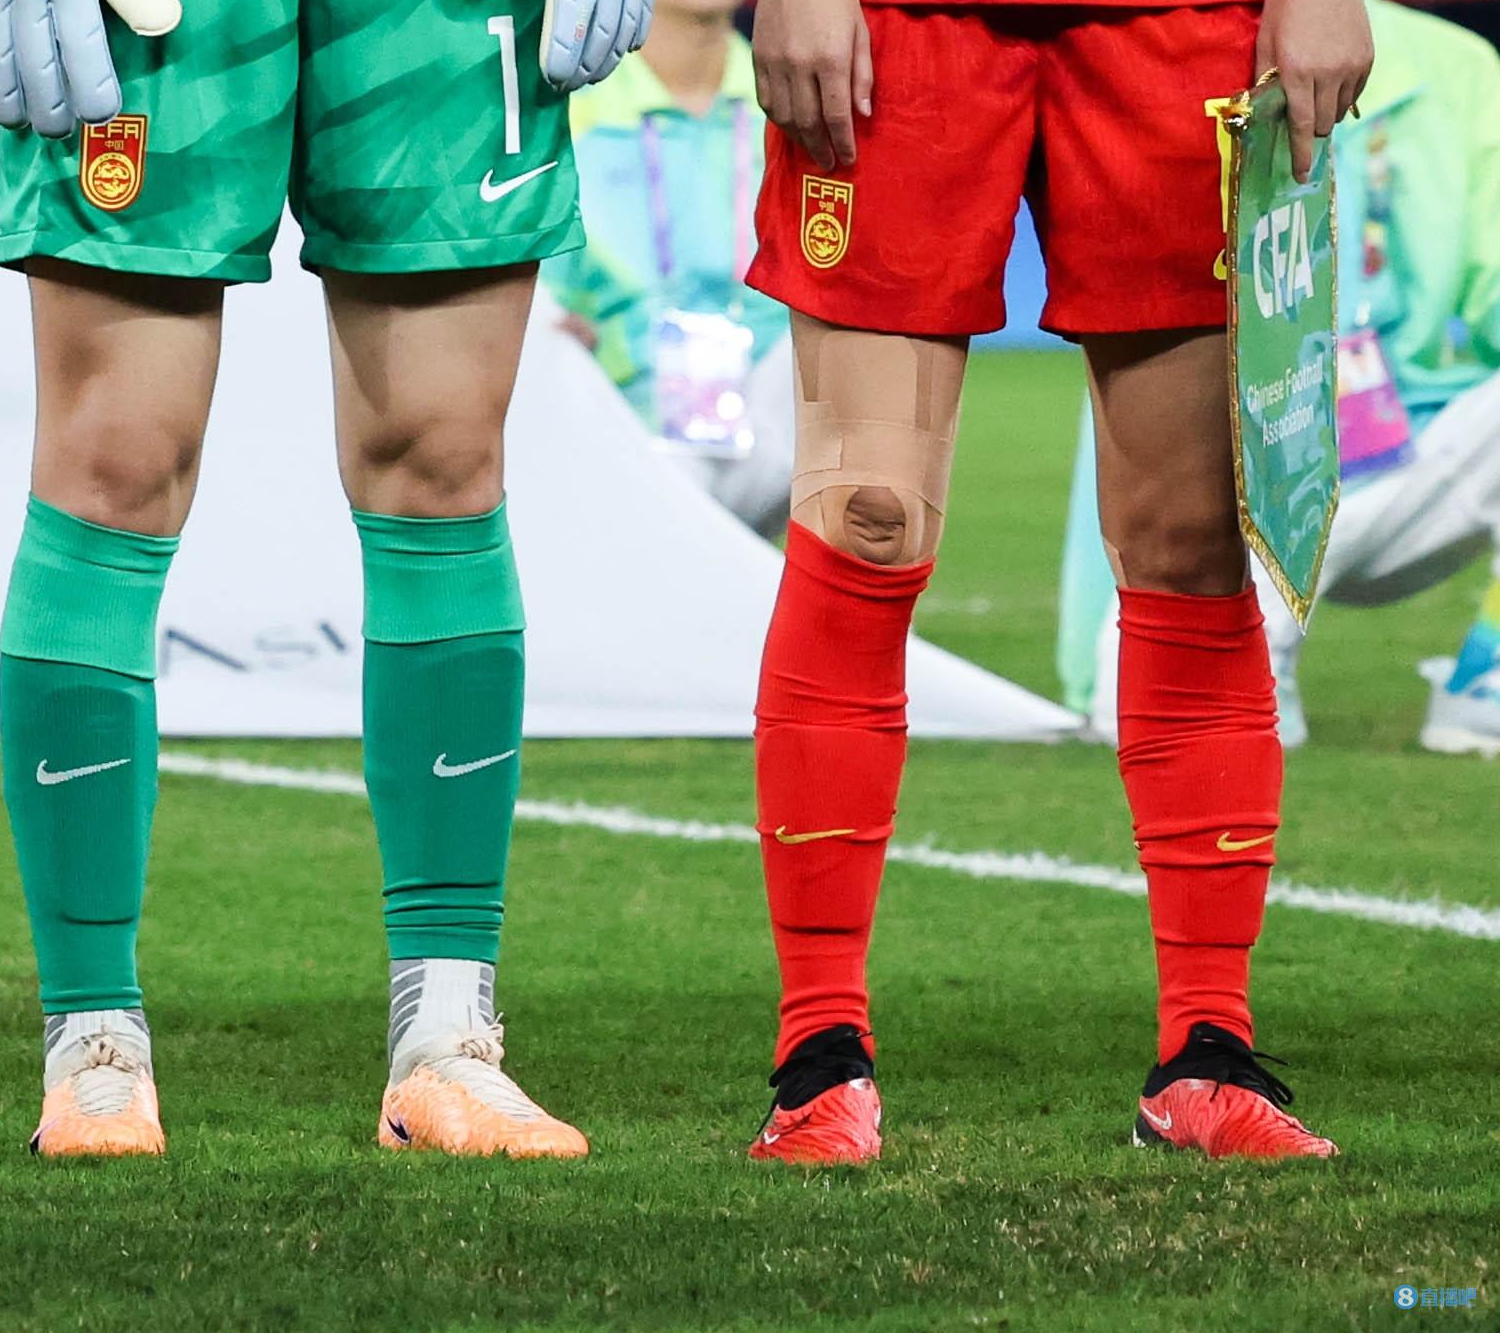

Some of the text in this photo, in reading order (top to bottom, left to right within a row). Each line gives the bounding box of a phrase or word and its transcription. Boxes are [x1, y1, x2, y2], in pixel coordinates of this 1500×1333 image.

[487, 15, 521, 154] 1
[105, 140, 124, 150] 中国
[807, 182, 848, 204] CFA
[1253, 199, 1314, 319] CFA
[1247, 379, 1284, 414] Chinese
[1262, 403, 1315, 448] Association
